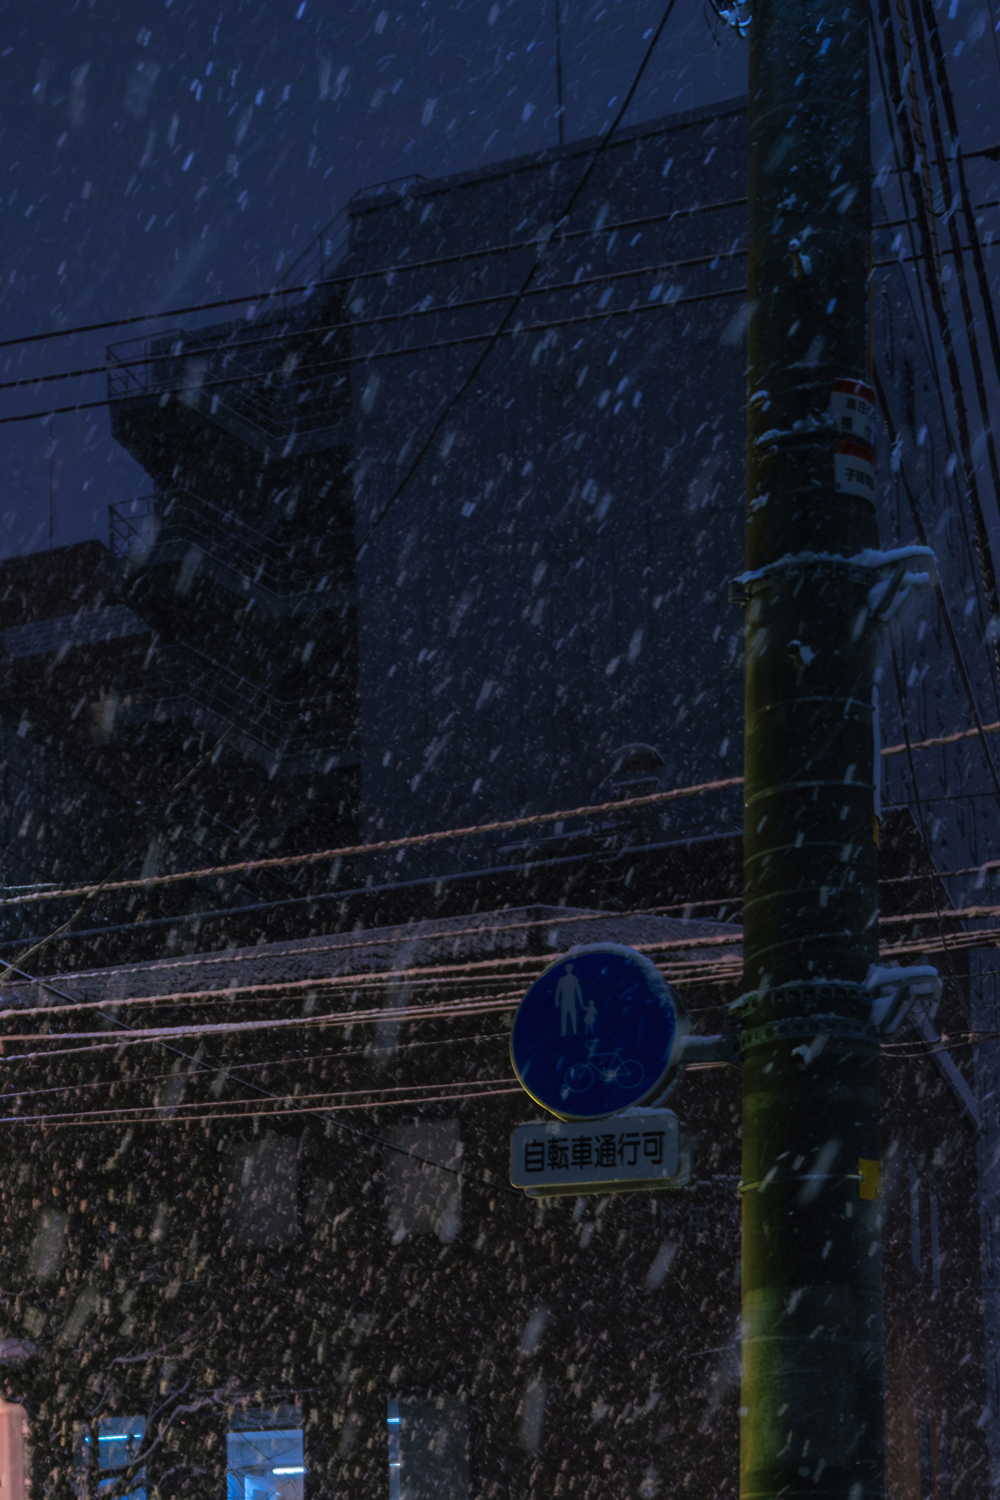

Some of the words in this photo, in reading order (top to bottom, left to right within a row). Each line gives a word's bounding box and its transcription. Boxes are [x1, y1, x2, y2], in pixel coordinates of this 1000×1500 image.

[525, 1131, 665, 1173] 自転車通行可
